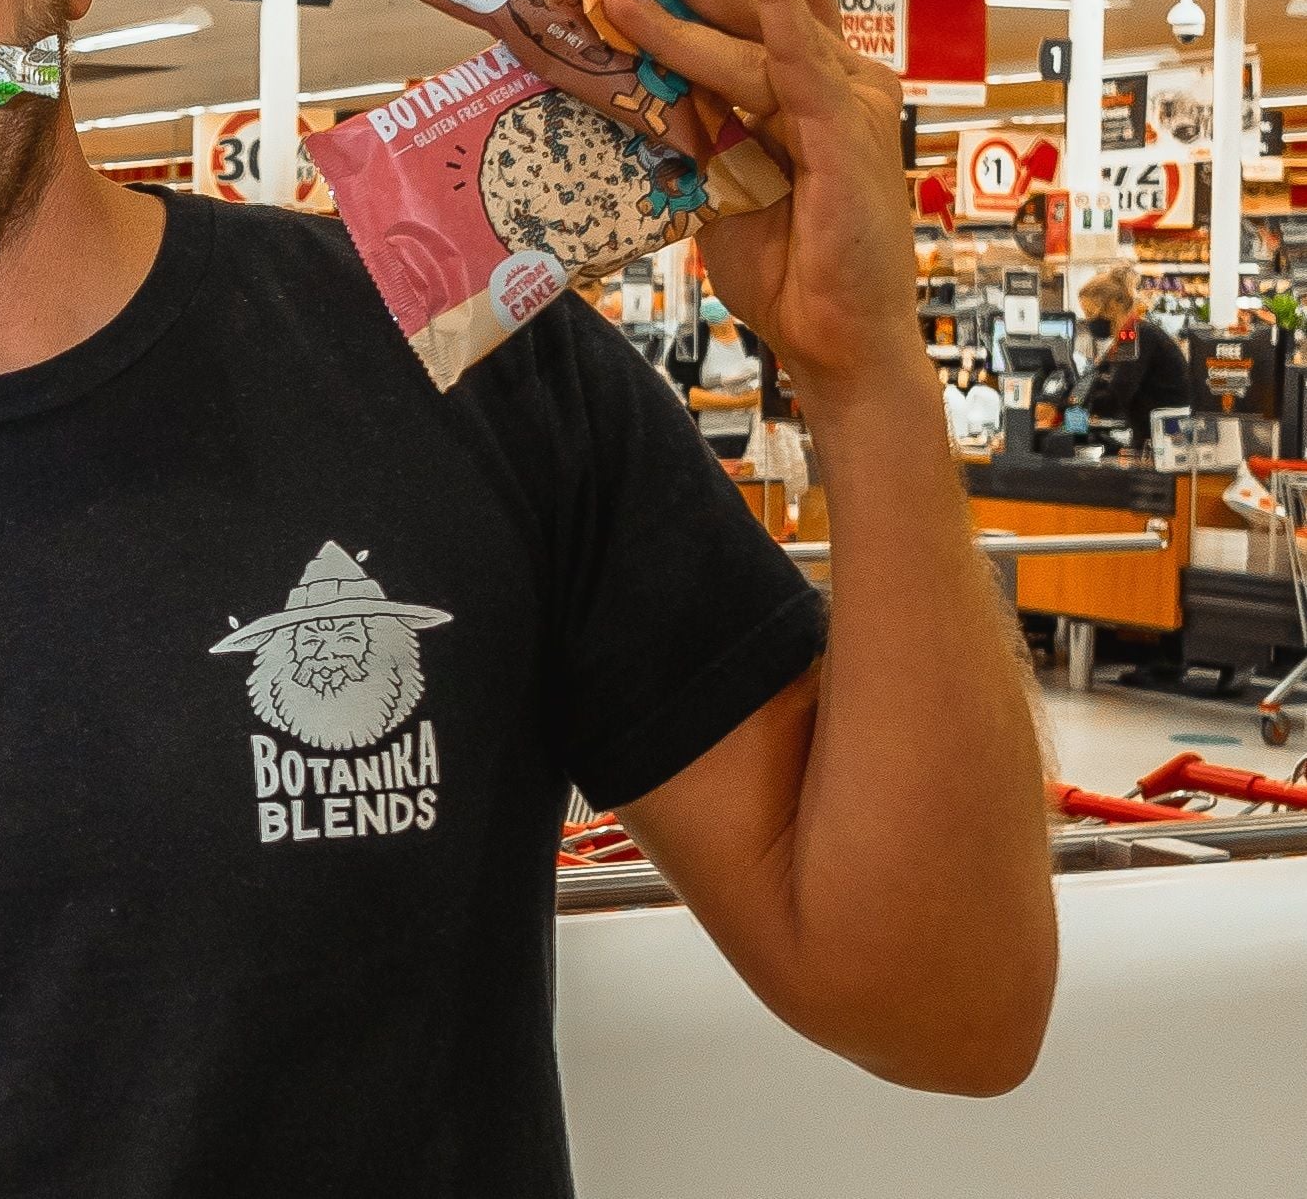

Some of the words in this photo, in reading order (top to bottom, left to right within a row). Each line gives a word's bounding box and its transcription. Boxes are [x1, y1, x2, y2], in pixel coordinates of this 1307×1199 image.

[546, 22, 566, 40] 60g
[563, 31, 584, 49] NET
[844, 14, 895, 33] RICES
[847, 34, 895, 54] OWN
[1050, 45, 1062, 74] 1
[366, 40, 522, 144] BOTANIKA
[413, 115, 458, 148] GLUTEN
[457, 98, 488, 123] FREE
[486, 81, 525, 107] VEGAN
[499, 260, 549, 307] BIRTHDAY
[509, 274, 562, 322] CAKE
[250, 720, 440, 799] BOTANIKA
[257, 787, 439, 843] BLENDS
